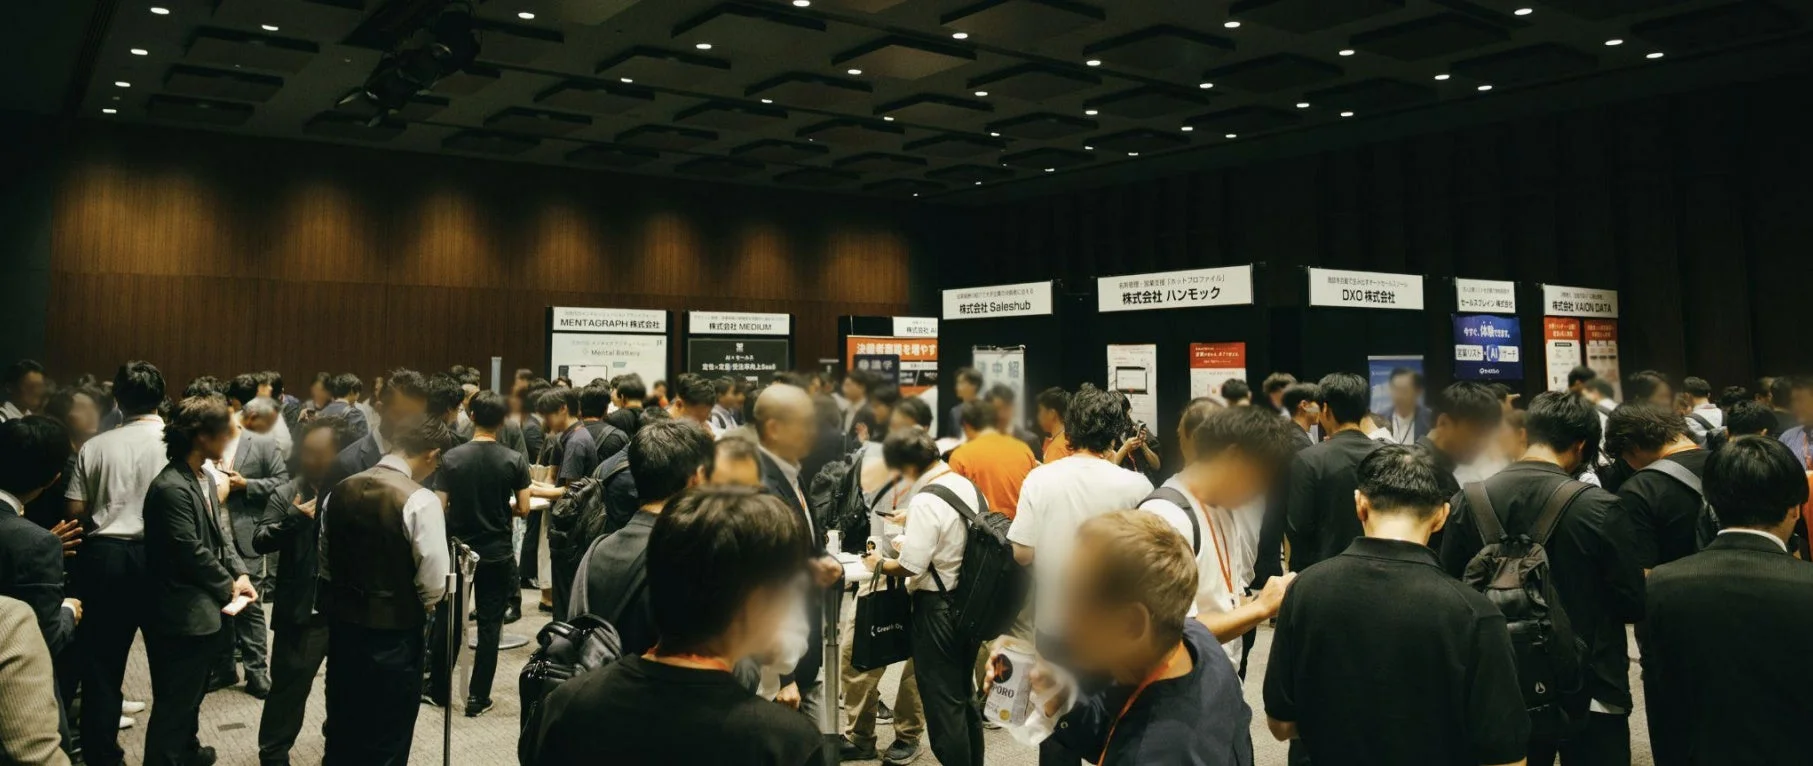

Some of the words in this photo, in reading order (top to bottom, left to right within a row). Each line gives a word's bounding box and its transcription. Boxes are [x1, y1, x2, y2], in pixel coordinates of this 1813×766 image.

[1122, 290, 1162, 305] 株式会社
[1166, 286, 1221, 301] ハンモック
[1342, 289, 1363, 301] DXO
[1364, 290, 1396, 304] 株式会社
[959, 302, 988, 314] 株式会社
[989, 300, 1031, 312] Saleshub
[1575, 302, 1594, 312] XAION
[1595, 303, 1612, 313] DATA
[560, 318, 628, 328] MENTAGRAPH
[630, 320, 660, 329] 株式会社
[709, 322, 737, 331] 株式会社
[738, 323, 772, 331] MEDIUM
